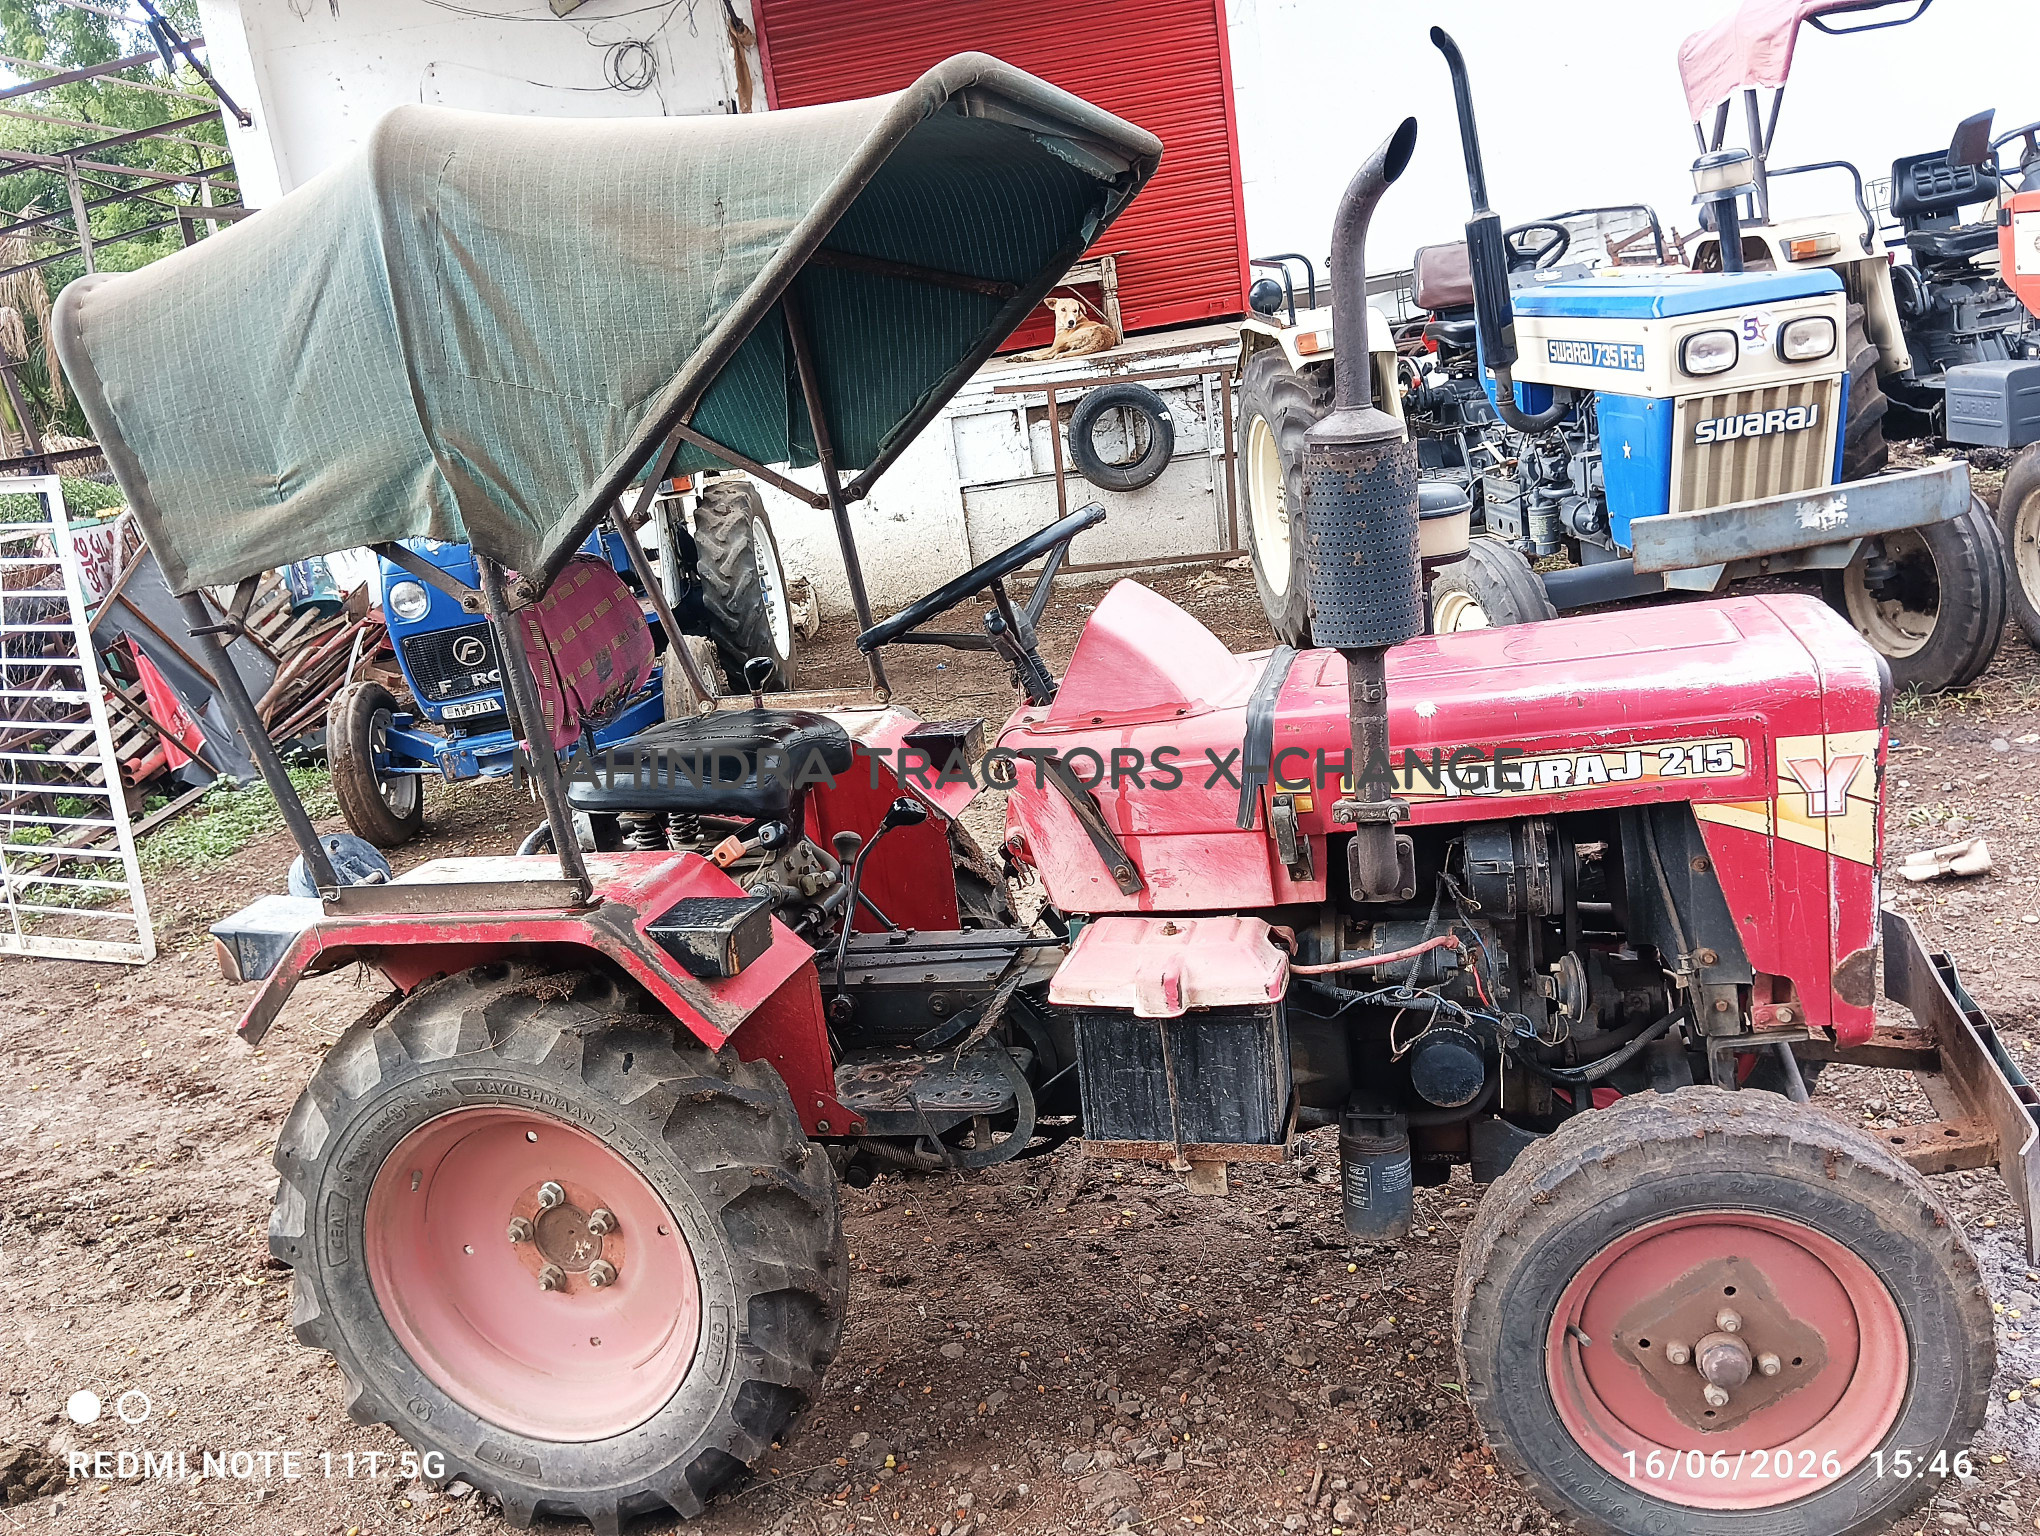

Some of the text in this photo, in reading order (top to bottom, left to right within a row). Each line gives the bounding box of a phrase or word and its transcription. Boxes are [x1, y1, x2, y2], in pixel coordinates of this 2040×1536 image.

[1593, 343, 1619, 368] 735
[1658, 742, 1734, 777] 215
[475, 1081, 596, 1125] AAYUSHMAAN
[329, 1207, 345, 1249] CEAT
[711, 1322, 725, 1367] CEAT
